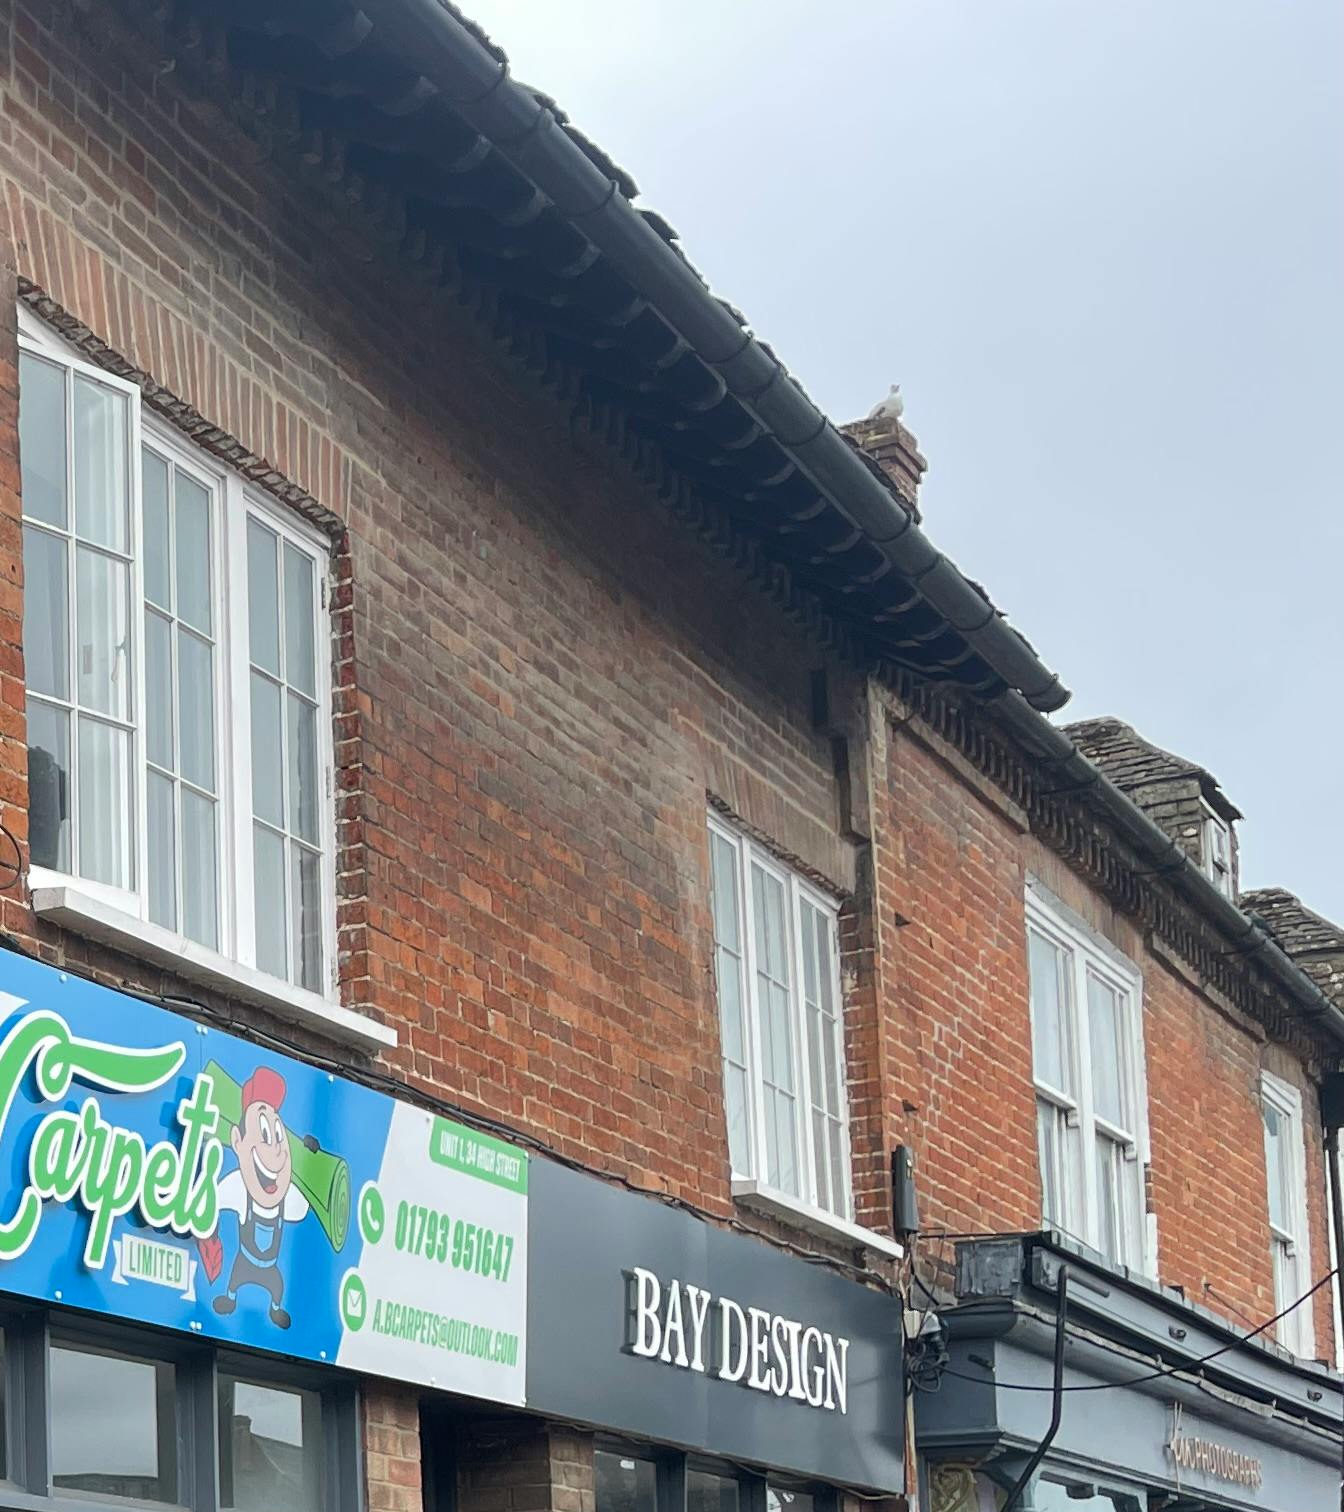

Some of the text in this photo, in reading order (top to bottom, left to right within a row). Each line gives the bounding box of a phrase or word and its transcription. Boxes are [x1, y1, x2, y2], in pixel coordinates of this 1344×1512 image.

[477, 1145, 496, 1173] HIGH
[496, 1151, 521, 1182] STREET
[127, 1248, 183, 1285] LIMITED
[394, 1200, 514, 1282] 01793 951647
[372, 1299, 519, 1368] A.BCARPETS@OUTLOOK.COM
[632, 1266, 850, 1415] BAY DESIGN
